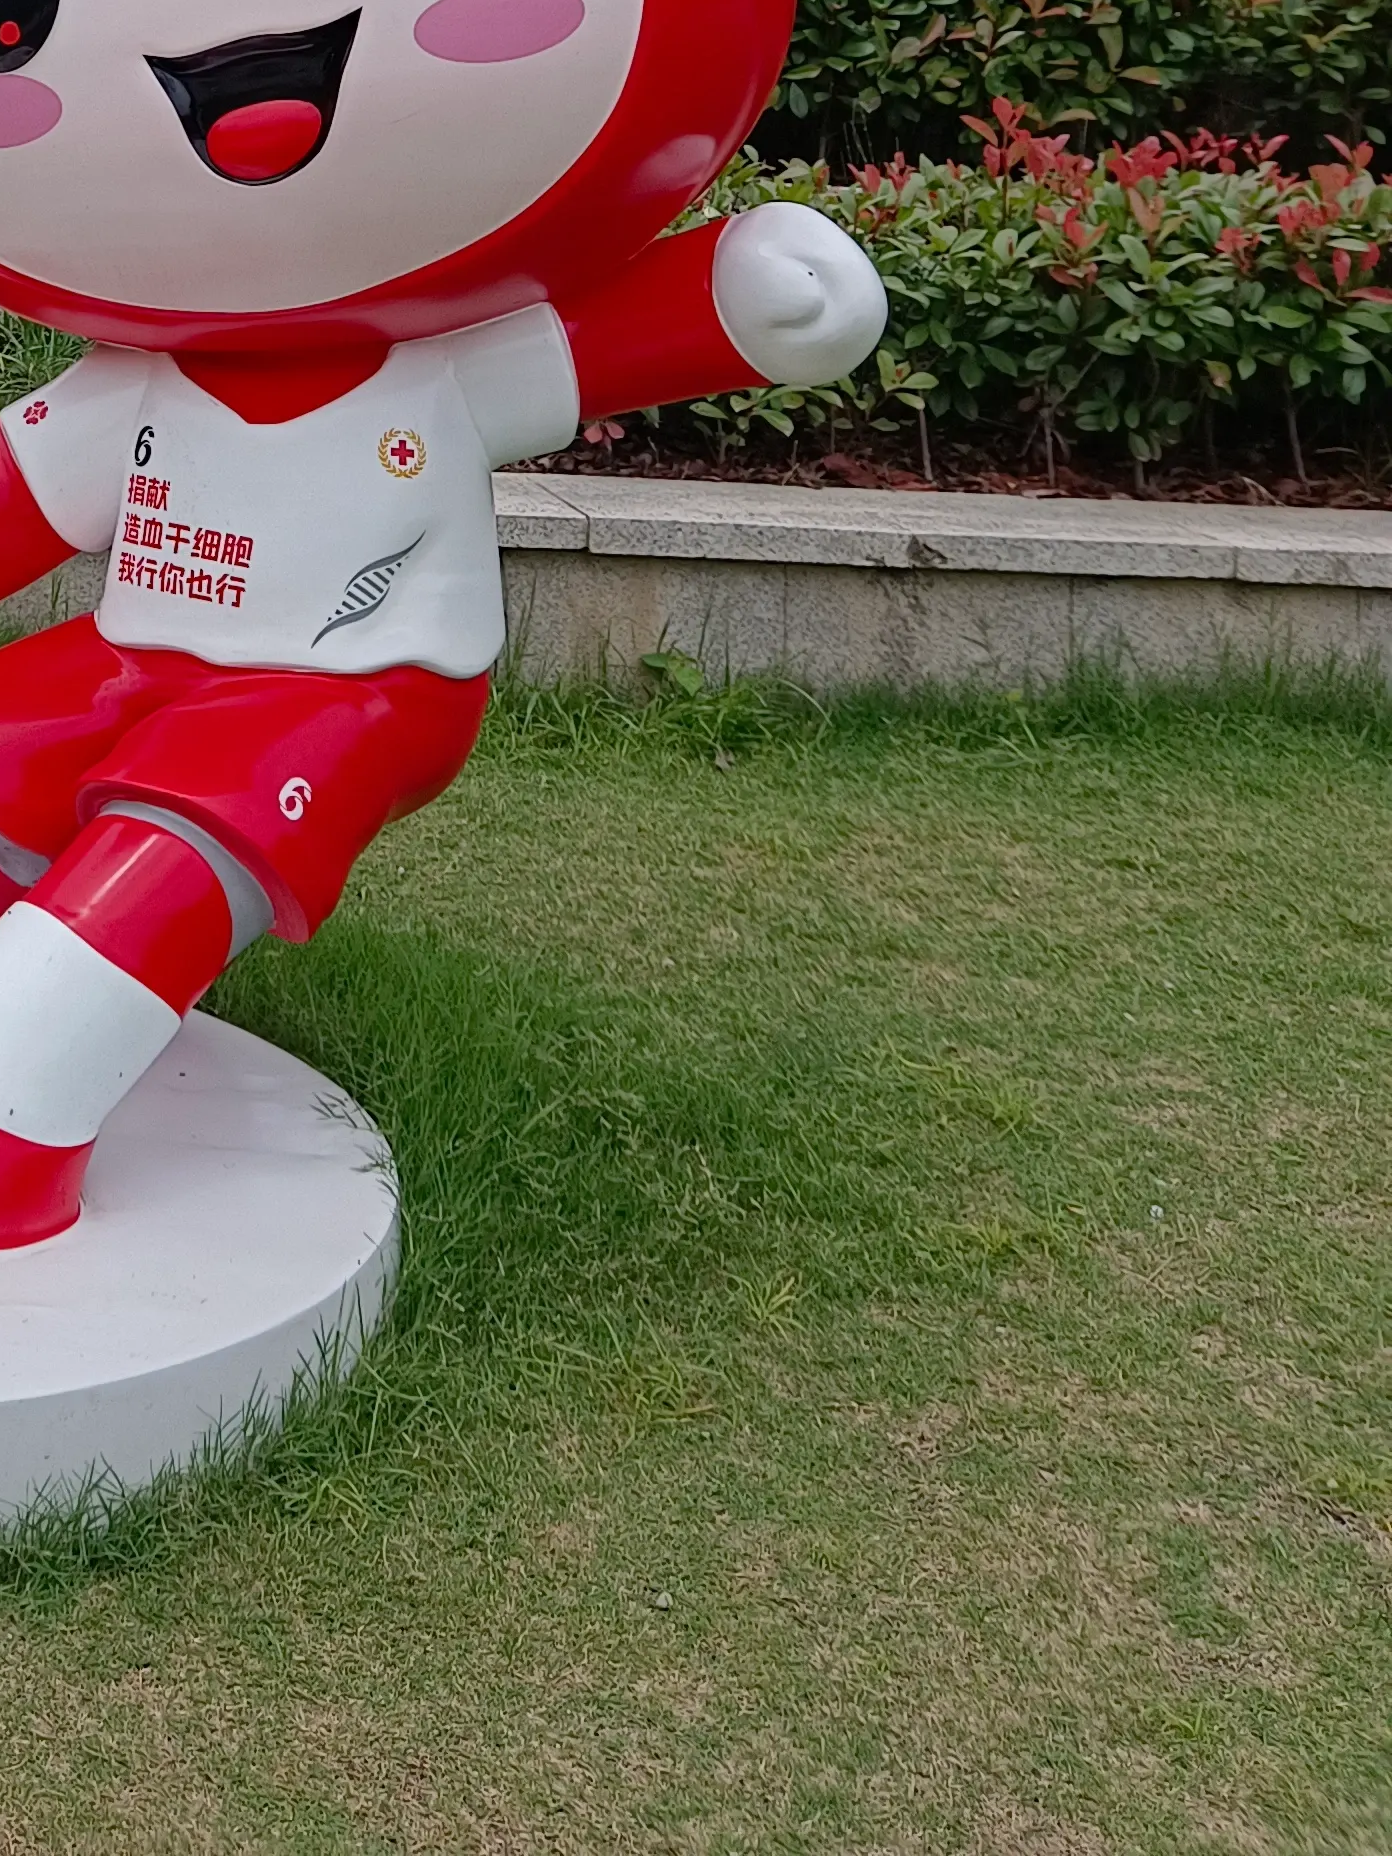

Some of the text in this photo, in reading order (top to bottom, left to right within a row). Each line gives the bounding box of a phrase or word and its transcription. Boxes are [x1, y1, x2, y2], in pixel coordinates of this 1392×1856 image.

[134, 425, 155, 467] 6
[127, 473, 171, 511] 捐献
[122, 512, 254, 568] 造血干细胞
[118, 551, 246, 608] 我行你也行
[279, 777, 312, 821] 6
